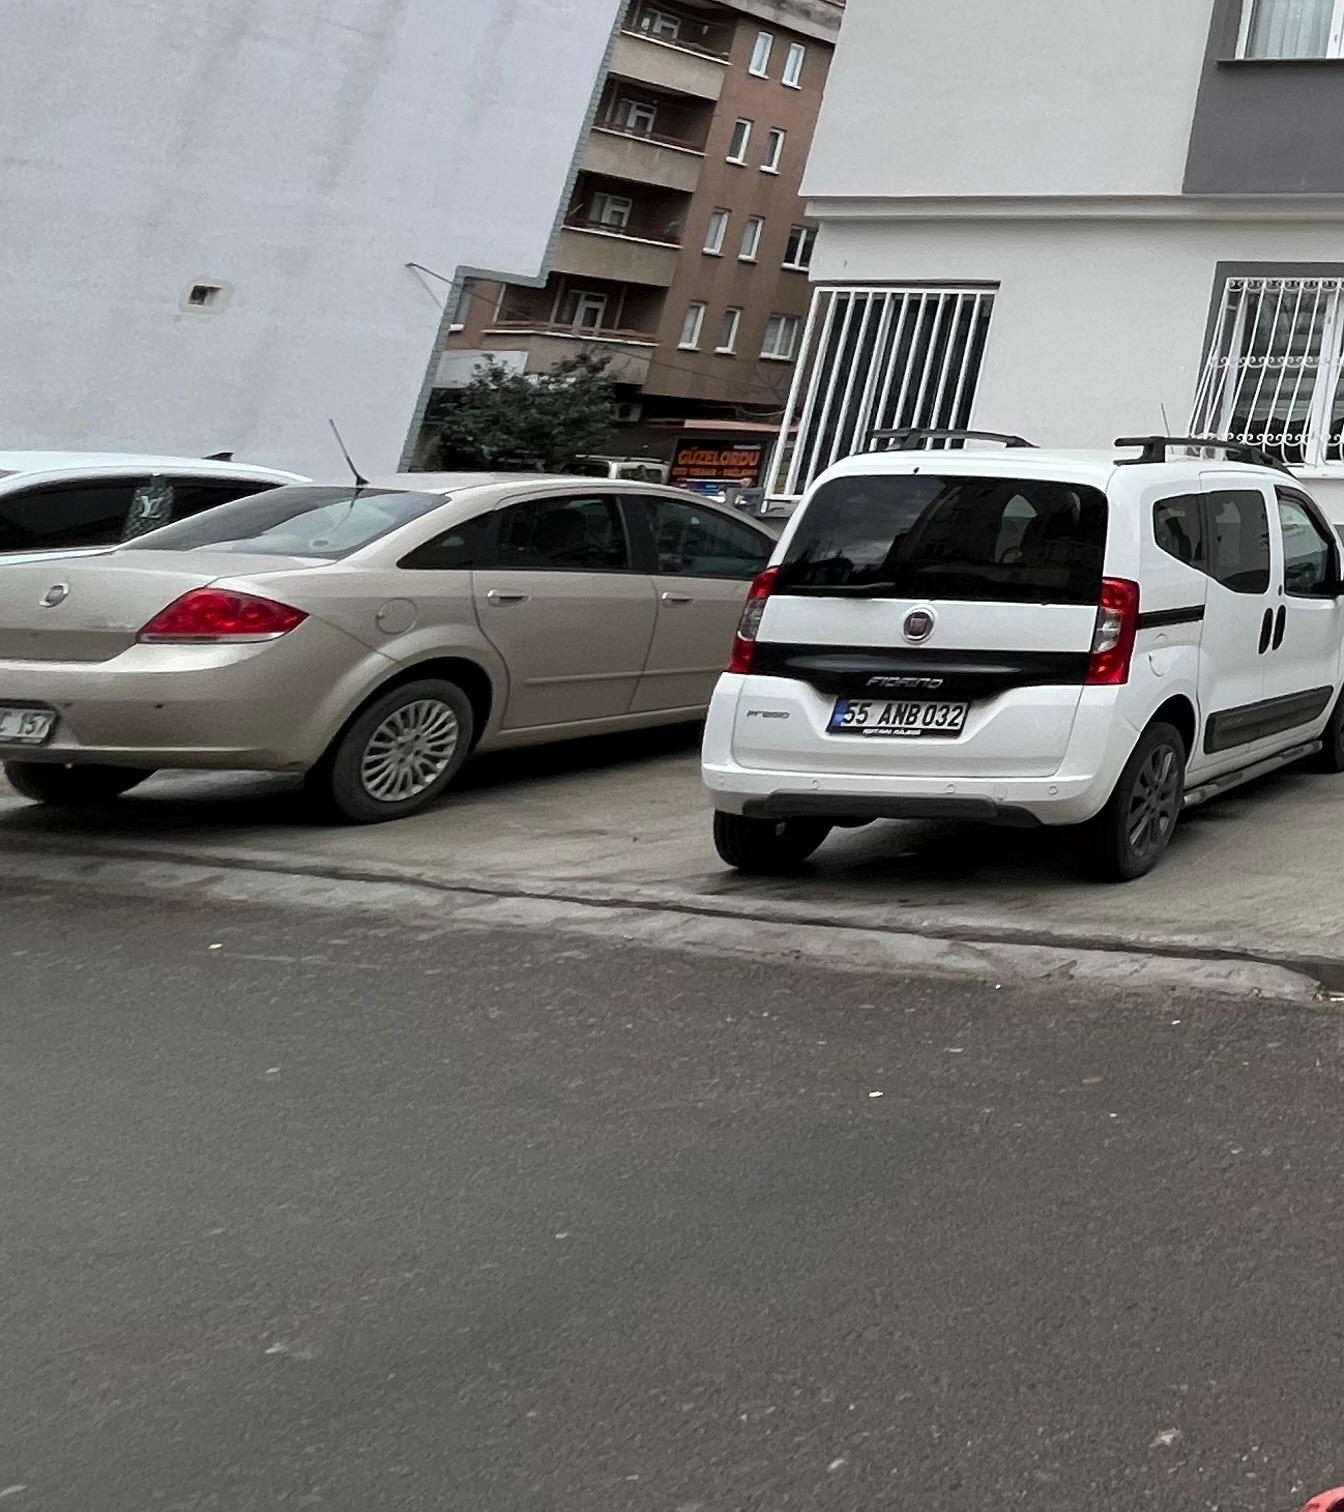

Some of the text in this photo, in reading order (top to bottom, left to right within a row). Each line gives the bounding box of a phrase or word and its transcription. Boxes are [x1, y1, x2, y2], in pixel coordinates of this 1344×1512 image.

[843, 702, 963, 727] 55 ANB 032
